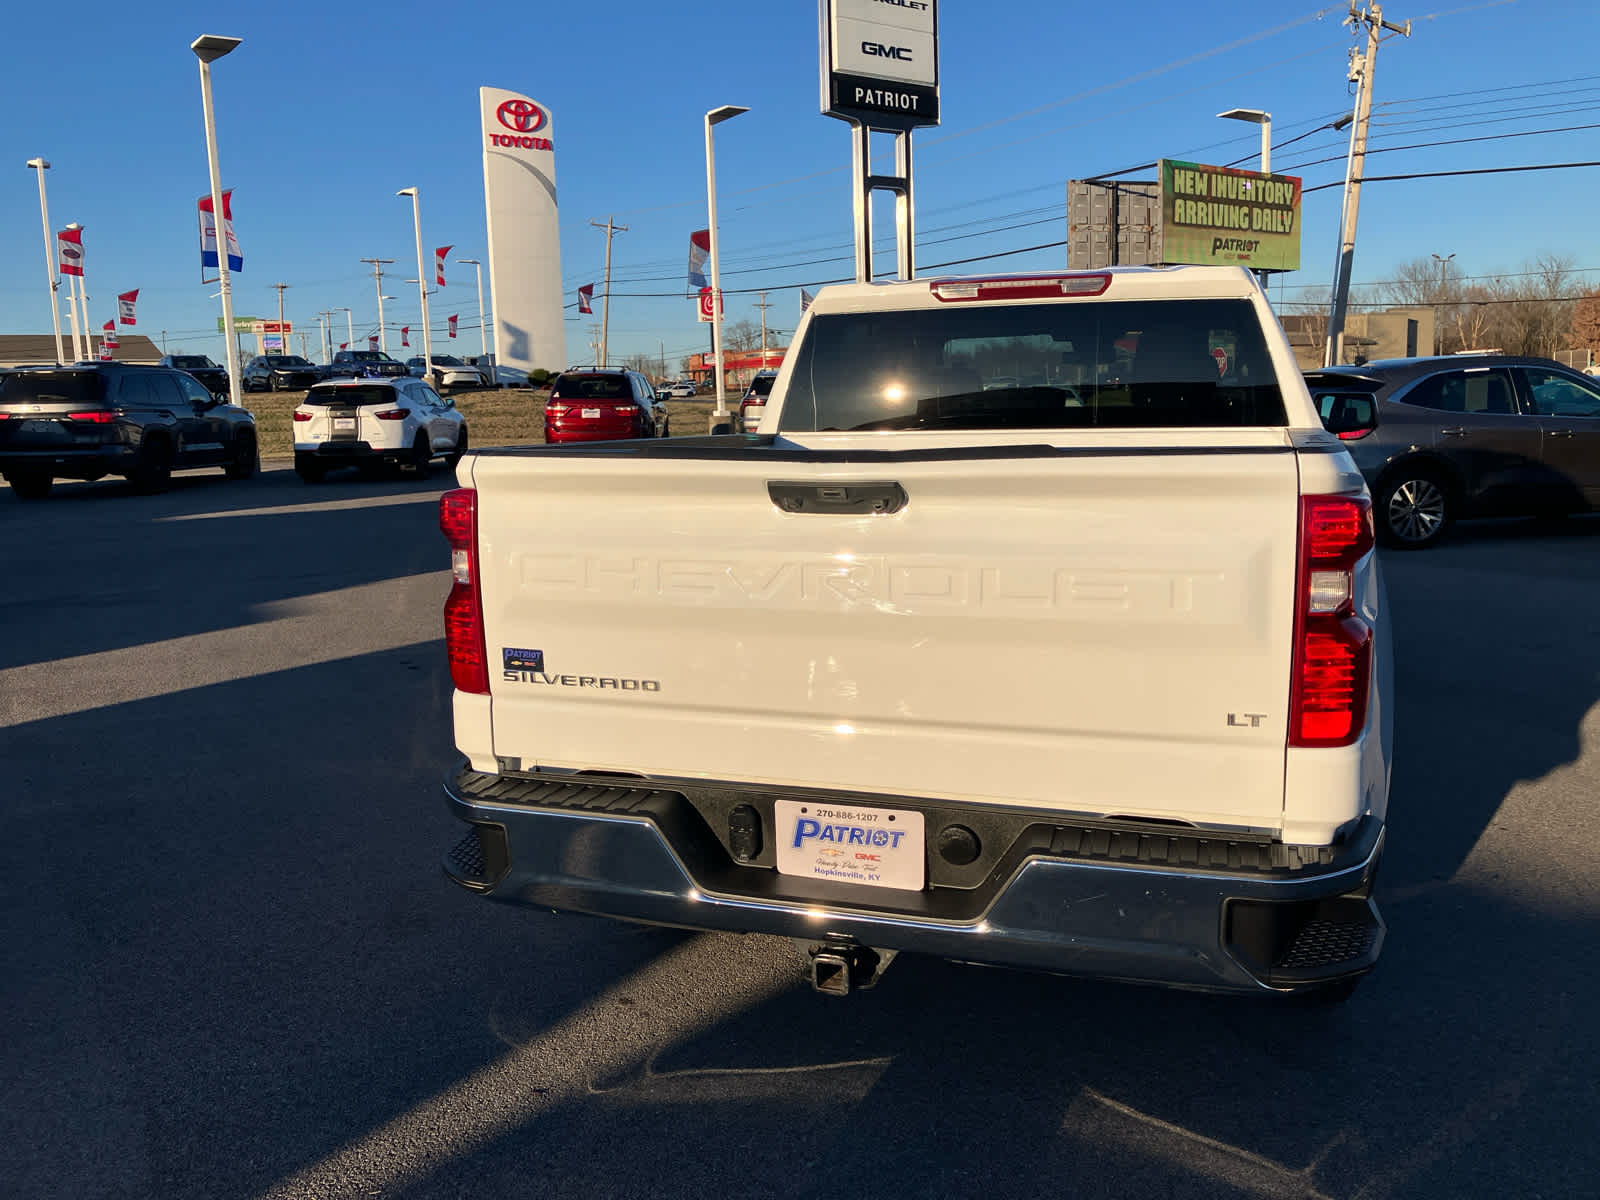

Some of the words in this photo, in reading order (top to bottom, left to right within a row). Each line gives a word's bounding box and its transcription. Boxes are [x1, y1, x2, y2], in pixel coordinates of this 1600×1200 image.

[862, 41, 913, 61] GMC
[855, 87, 919, 110] PATRIOT
[489, 133, 553, 151] TOYOTA
[1174, 168, 1209, 196] NEW
[1211, 174, 1294, 205] INVENTORY
[1174, 198, 1249, 229] ARRIVING
[1252, 208, 1294, 233] DAILY
[1212, 237, 1260, 256] PATRIOT
[517, 552, 1225, 612] CHEVROLET
[505, 648, 542, 661] PATRIOT
[503, 670, 661, 692] SILVERADO
[1227, 712, 1267, 727] LT
[816, 809, 878, 822] 270-886-1207
[792, 816, 905, 849] PATRIOT
[855, 852, 881, 862] GMC
[814, 866, 866, 880] Hopkinsville,
[868, 873, 881, 881] KY
